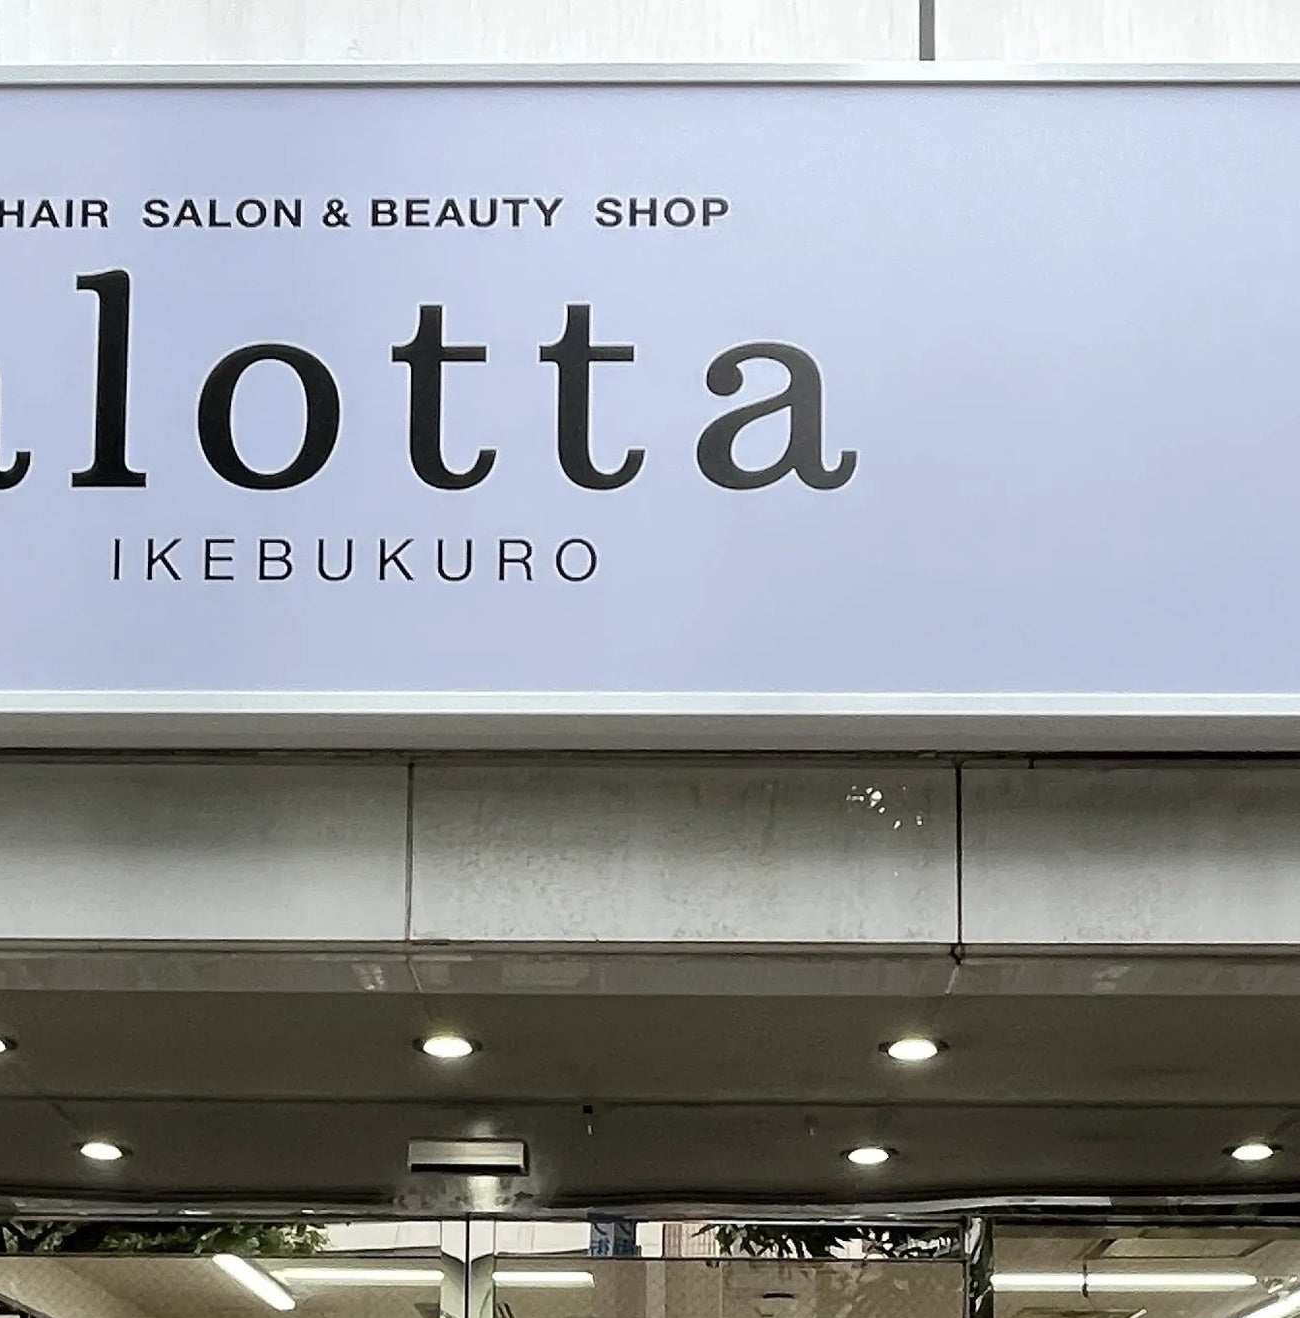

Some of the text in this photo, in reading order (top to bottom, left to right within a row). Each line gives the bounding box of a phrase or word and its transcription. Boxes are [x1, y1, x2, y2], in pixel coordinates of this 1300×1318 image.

[141, 198, 303, 229] SALON
[321, 198, 352, 229] &
[370, 196, 564, 229] BEAUTY
[594, 196, 731, 229] SHOP
[112, 537, 599, 583] IKEBUKURO
